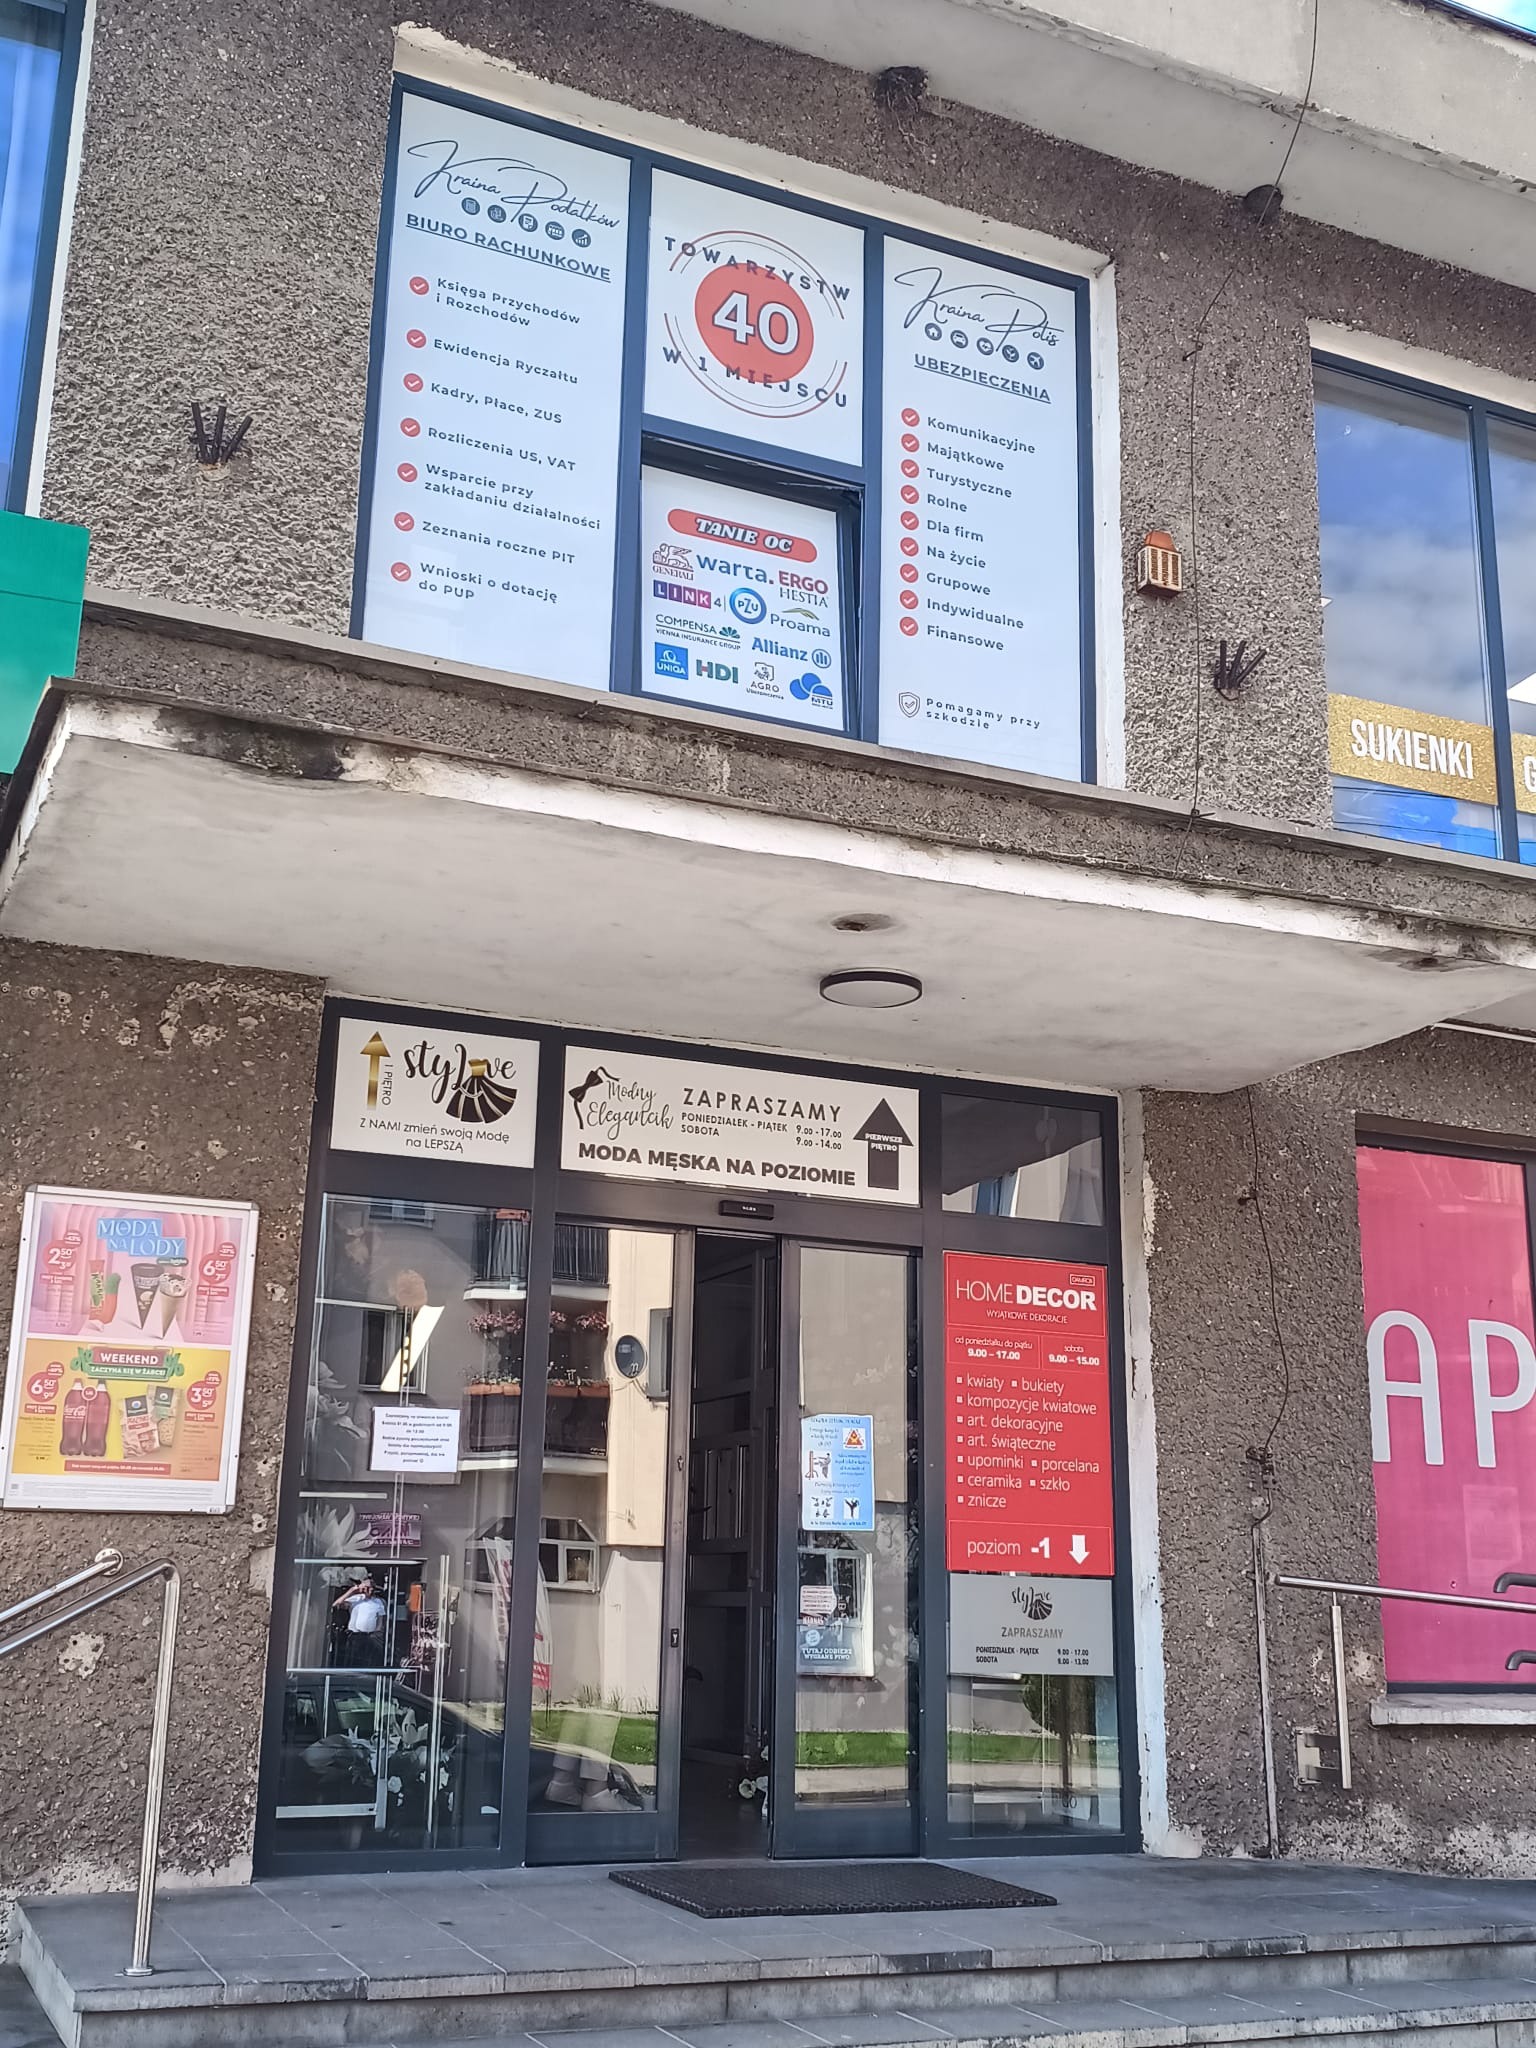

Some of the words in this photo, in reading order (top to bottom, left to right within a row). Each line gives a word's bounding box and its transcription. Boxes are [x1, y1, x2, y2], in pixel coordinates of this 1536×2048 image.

[407, 140, 535, 198] Kraina
[498, 166, 620, 228] Podatków
[406, 213, 467, 240] BIURO
[475, 232, 611, 281] RACHUNKOWE
[664, 236, 850, 300] TOWARZYSTW
[437, 278, 486, 300] Księga
[492, 292, 581, 325] Przychodów
[446, 296, 530, 326] Rozchodów
[894, 267, 1016, 329] Kraina
[980, 293, 1065, 352] Polis
[712, 290, 800, 355] 40
[434, 339, 510, 367] Ewidencja
[515, 359, 578, 384] Ryczałtu
[662, 346, 681, 364] W
[699, 357, 708, 372] 1
[726, 367, 847, 407] MIEJSCU
[914, 353, 1051, 402] UBEZPIECZENIA
[431, 383, 479, 405] Kadry,
[484, 396, 528, 417] Płace,
[534, 408, 562, 424] ZUS
[927, 416, 1036, 454] Komunikacyjne
[428, 427, 513, 456] Rozliczenia
[519, 449, 542, 465] US,
[547, 456, 577, 471] VAT
[927, 442, 1005, 470] Majątkowe
[426, 463, 497, 489] Wsparcie
[502, 481, 534, 498] przy
[927, 467, 1012, 498] Turystyczne
[425, 481, 507, 508] zakładaniu
[513, 501, 601, 530] działalności
[927, 493, 967, 512] Rolne
[695, 517, 759, 545] TANIE
[764, 535, 793, 553] OC
[927, 519, 950, 534] Dla
[955, 526, 984, 542] firm
[422, 521, 491, 545] Zeznania
[497, 539, 546, 557] roczne
[552, 551, 576, 564] PIT
[927, 545, 945, 559] Na
[950, 551, 986, 568] życie
[420, 562, 482, 585] Wnioski
[488, 579, 496, 588] o
[501, 581, 558, 603] dotację
[652, 565, 694, 581] GENERALI
[779, 570, 828, 594] ERGO
[926, 572, 991, 595] Grupowe
[419, 580, 437, 592] do
[444, 585, 475, 599] PUP
[656, 584, 709, 606] LINK
[779, 586, 829, 608] HESTIA
[738, 598, 759, 614] PZU
[927, 598, 1024, 629] Indywidualne
[655, 614, 717, 635] COMPENSA
[770, 613, 831, 637] Proama
[655, 629, 680, 639] VIENNA
[681, 633, 717, 647] INSURANCE
[719, 641, 741, 650] GROUP
[927, 624, 1004, 650] Finansowe
[751, 637, 809, 661] Allianz
[657, 662, 686, 675] UNIQA
[696, 659, 739, 684] HDI
[750, 681, 780, 693] AGRO
[926, 698, 1003, 721] Pomagamy
[1010, 716, 1040, 729] przy
[926, 711, 990, 729] szkodzie
[1351, 718, 1475, 780] SUKIENKI
[381, 1071, 393, 1106] PIĘTRO
[606, 1080, 656, 1110] Modny
[683, 1087, 841, 1123] ZAPRASZAMY
[360, 1118, 366, 1128] Z
[369, 1120, 401, 1131] NAMI
[403, 1122, 437, 1136] zmień
[440, 1127, 473, 1141] swoją
[476, 1130, 510, 1145] Modę
[681, 1112, 748, 1128] PONIEDZIAŁEK
[757, 1120, 788, 1133] PIĄTEK
[796, 1125, 813, 1135] 9.00
[405, 1138, 421, 1148] na
[425, 1139, 464, 1153] LEPSZĄ
[681, 1125, 720, 1137] SOBOTA
[796, 1137, 813, 1147] 9.00
[865, 1133, 903, 1144] PIERWSZE
[870, 1142, 898, 1152] PIĘTRO
[578, 1142, 642, 1164] MODA
[648, 1149, 720, 1171] MĘSKA
[726, 1159, 755, 1176] NA
[761, 1162, 856, 1187] POZIOMIE
[99, 1220, 160, 1237] MODA
[110, 1238, 127, 1250] NA
[129, 1239, 184, 1256] LODY
[956, 1279, 1013, 1304] HOME
[1016, 1285, 1097, 1311] DECOR
[986, 1310, 1028, 1322] WYJĄTKOWE
[1030, 1313, 1068, 1324] DEKORACJE
[955, 1336, 964, 1344] od
[1005, 1340, 1013, 1348] do
[1064, 1345, 1084, 1353] sobota
[100, 1353, 158, 1365] WEEKEND
[968, 1348, 987, 1358] 9.00
[996, 1351, 1021, 1360] 17.00
[1048, 1354, 1068, 1364] 9.00
[1076, 1356, 1100, 1366] 15.00
[91, 1366, 122, 1374] ZACZYNA
[967, 1373, 1004, 1393] kwiaty
[1022, 1376, 1064, 1396] bukiety
[1366, 1310, 1536, 1468] AP
[967, 1393, 1039, 1414] kompozycje
[1042, 1398, 1097, 1415] kwiatowe
[967, 1416, 987, 1427] art.
[991, 1416, 1063, 1434] dekoracyjne
[967, 1436, 987, 1447] art.
[991, 1435, 1056, 1451] świąteczne
[967, 1455, 1024, 1470] upominki
[1041, 1458, 1100, 1473] porcelana
[967, 1474, 1022, 1489] ceramika
[1040, 1478, 1070, 1492] szkło
[967, 1494, 1007, 1508] znicze
[967, 1539, 1021, 1557] poziom
[1031, 1537, 1050, 1559] -1
[1001, 1626, 1064, 1639] ZAPRASZAMY
